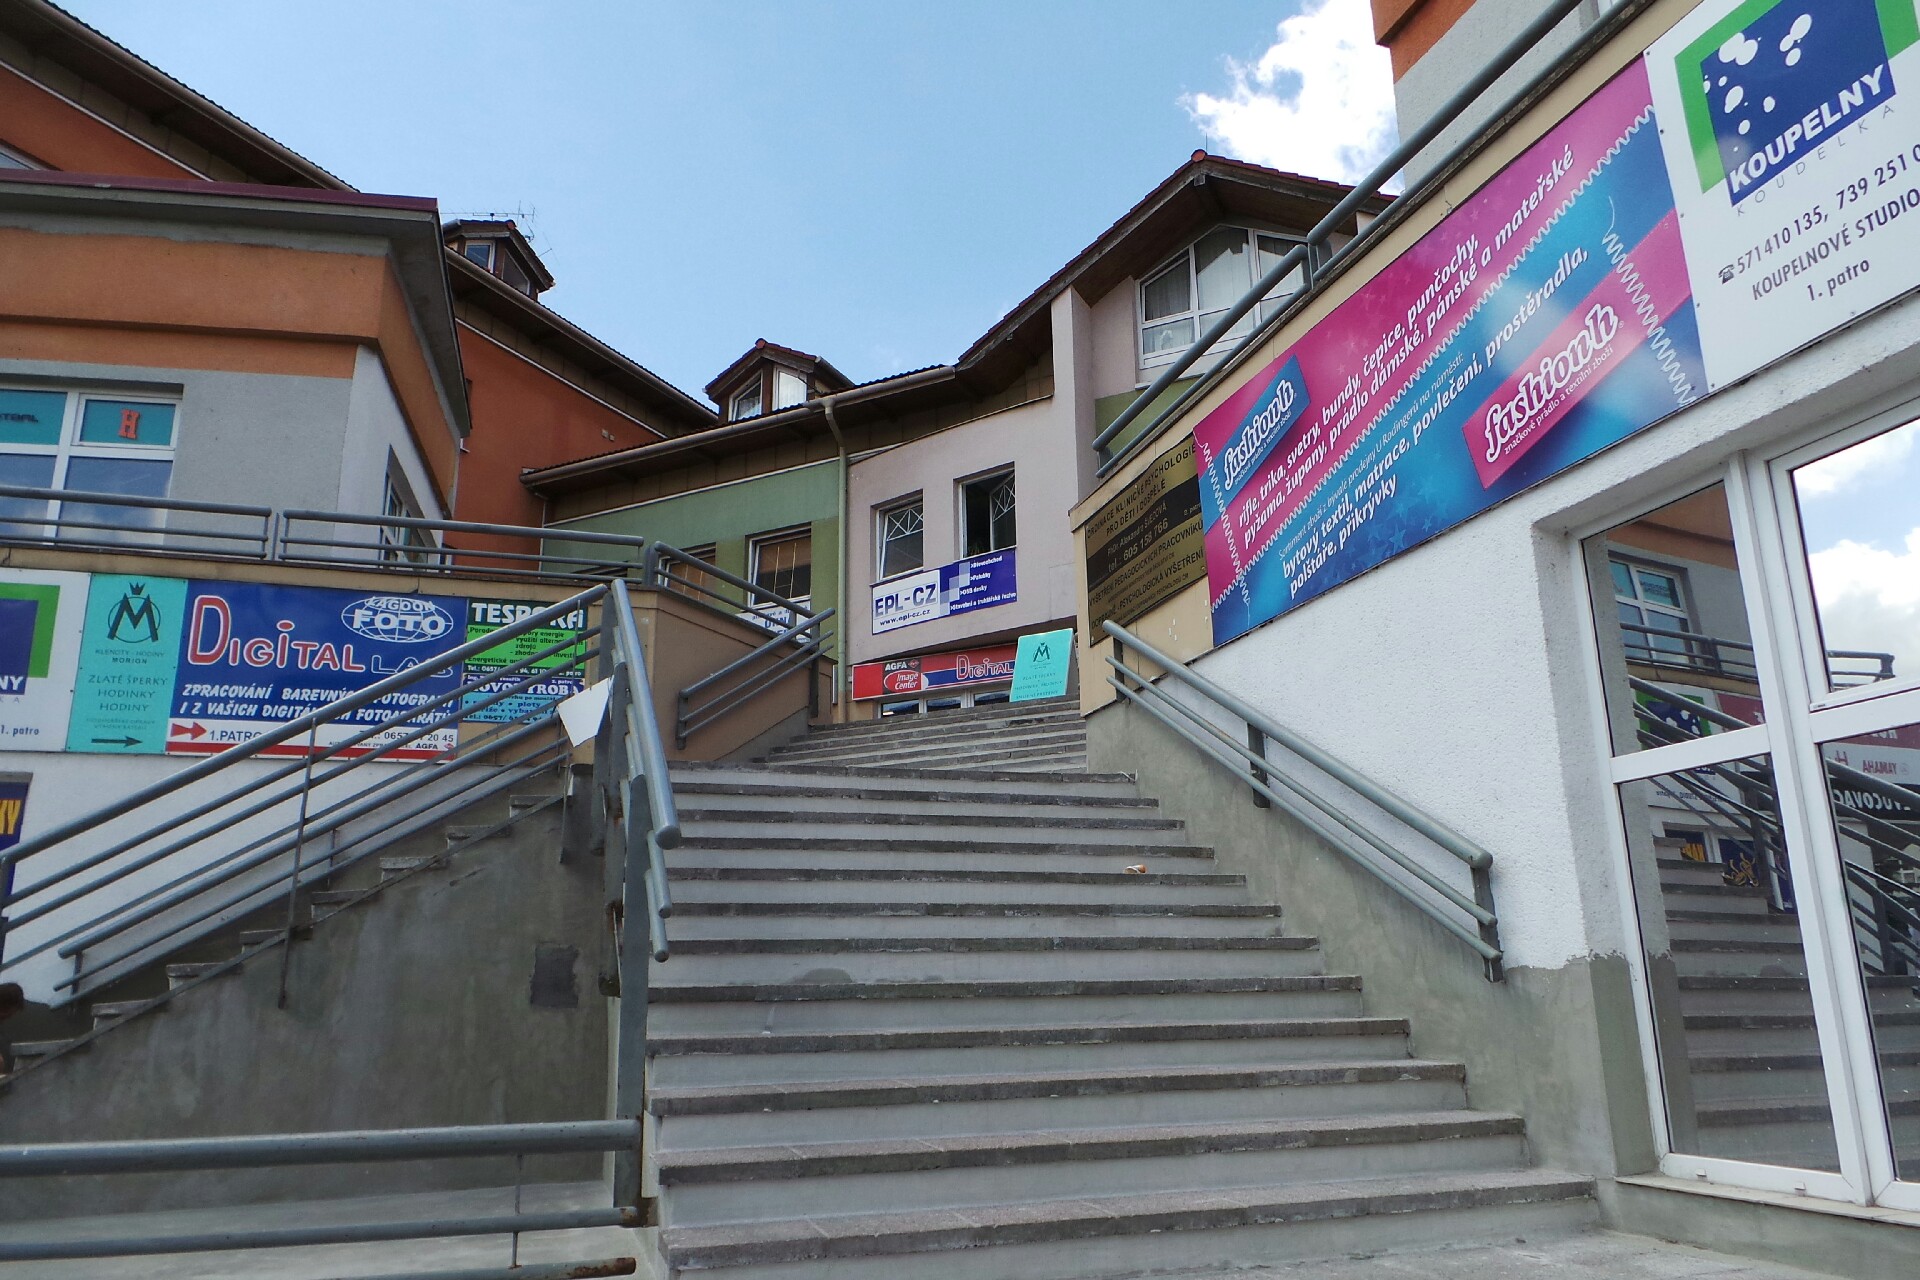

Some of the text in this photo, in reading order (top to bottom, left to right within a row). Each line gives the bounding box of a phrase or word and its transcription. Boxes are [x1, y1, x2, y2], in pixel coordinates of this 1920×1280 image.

[1729, 64, 1883, 194] KOUPELNY
[1737, 104, 1895, 217] KOUDELKA
[1836, 177, 1868, 210] 739
[1874, 154, 1907, 187] 251
[1752, 188, 1920, 300] KOUPELNOVÉ STUDIO
[1807, 259, 1870, 301] 1. patro
[1244, 144, 1574, 550] pyžama, župany, prádlo dámské, pánské a mateřské
[1239, 233, 1478, 528] rifle, trika, svetry, bundy, čepice, punčochy,
[1504, 419, 1536, 455] značkové
[1536, 399, 1560, 427] prádlo
[1565, 366, 1592, 396] textilní
[1592, 345, 1614, 370] zboží
[1282, 247, 1588, 579] bytový textil, matrace, povlečení, prostěradla,
[1348, 450, 1376, 486] prodejny
[1419, 390, 1430, 407] na
[1144, 443, 1197, 490] PSYCHOLOGIE
[1106, 521, 1119, 537] PRO
[1120, 508, 1135, 526] DĚTI
[1140, 479, 1166, 511] DOSPĚLÉ
[1123, 543, 1138, 560] 605
[1154, 517, 1168, 537] 766
[1289, 473, 1397, 601] polštáře, přikrývky
[1164, 546, 1204, 578] VYŠETŘENÍ
[875, 582, 937, 618] EPL-CZ
[880, 609, 931, 626] www.epl-cz.cz
[353, 608, 446, 636] FOTO
[88, 674, 168, 686] ZLATÉ ŠPERKY
[885, 661, 907, 671] AGFA
[895, 681, 918, 691] Center
[897, 673, 919, 682] Image
[97, 688, 156, 699] HODINKY
[99, 702, 150, 712] HODINY
[182, 683, 274, 700] ZPRACOVÁNÍ
[281, 687, 356, 702] BAREVNÝ
[191, 703, 202, 714] Z
[207, 700, 258, 716] VAŠICH
[12, 726, 40, 737] patro
